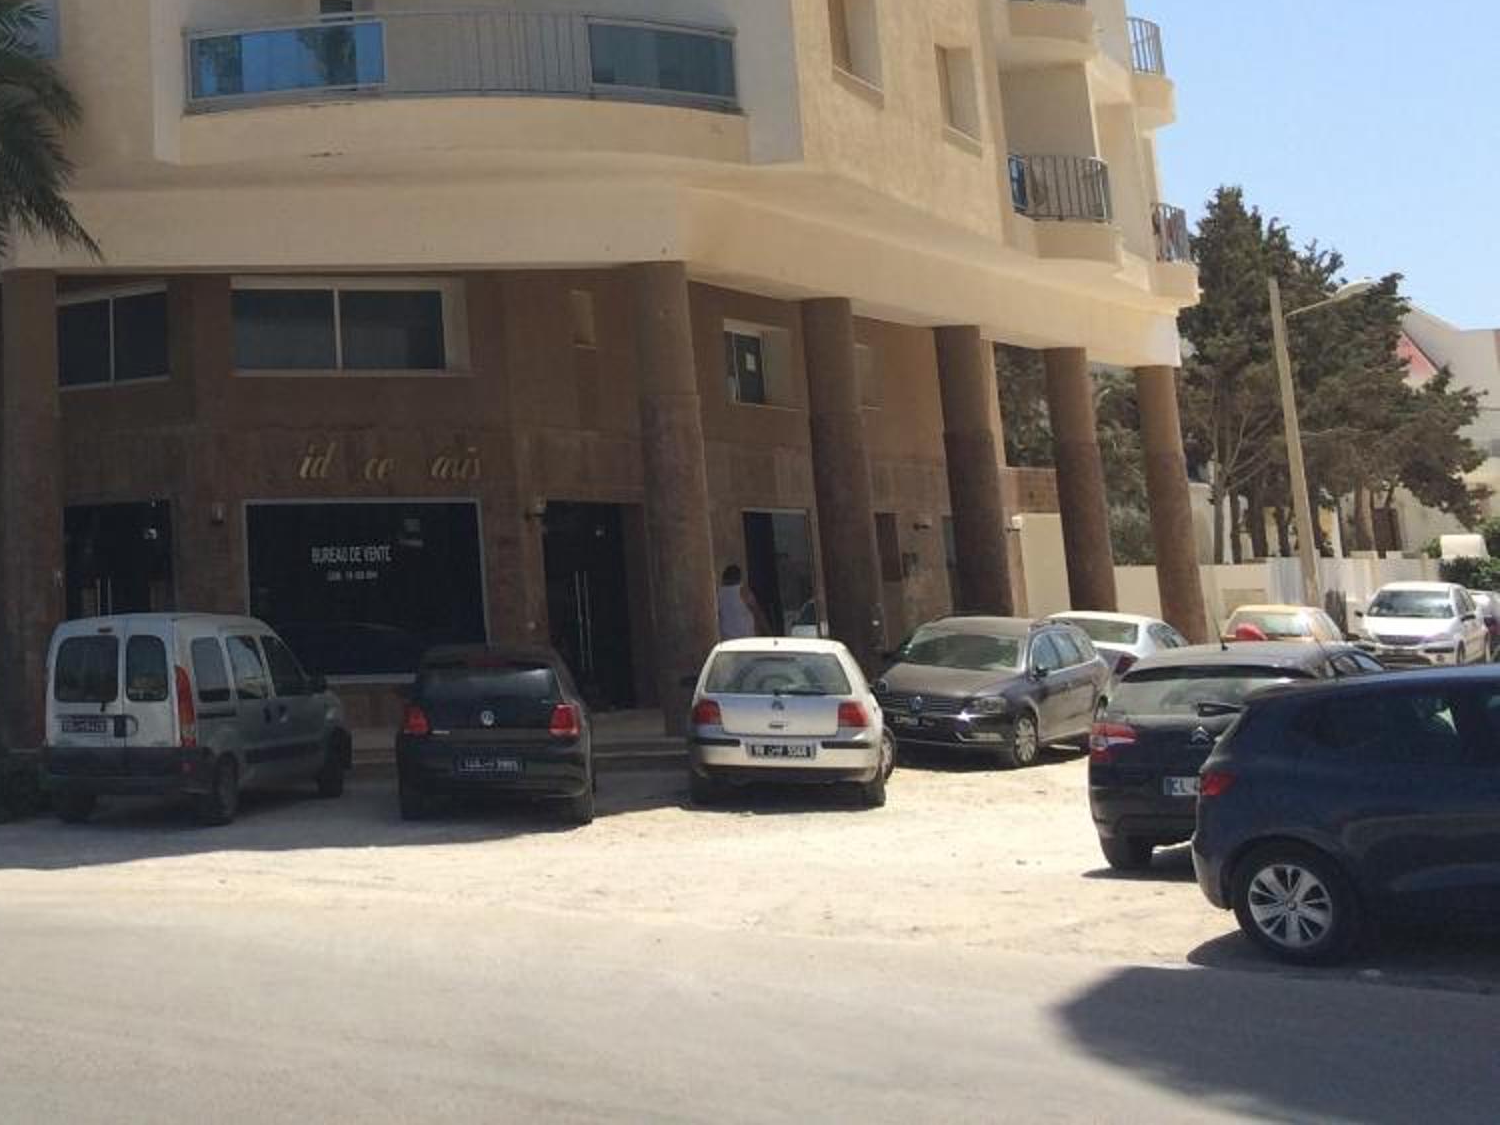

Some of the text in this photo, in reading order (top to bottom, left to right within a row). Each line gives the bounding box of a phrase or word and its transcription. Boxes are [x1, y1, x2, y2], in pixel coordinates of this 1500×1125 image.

[311, 545, 392, 564] BUREAU DE VENTE
